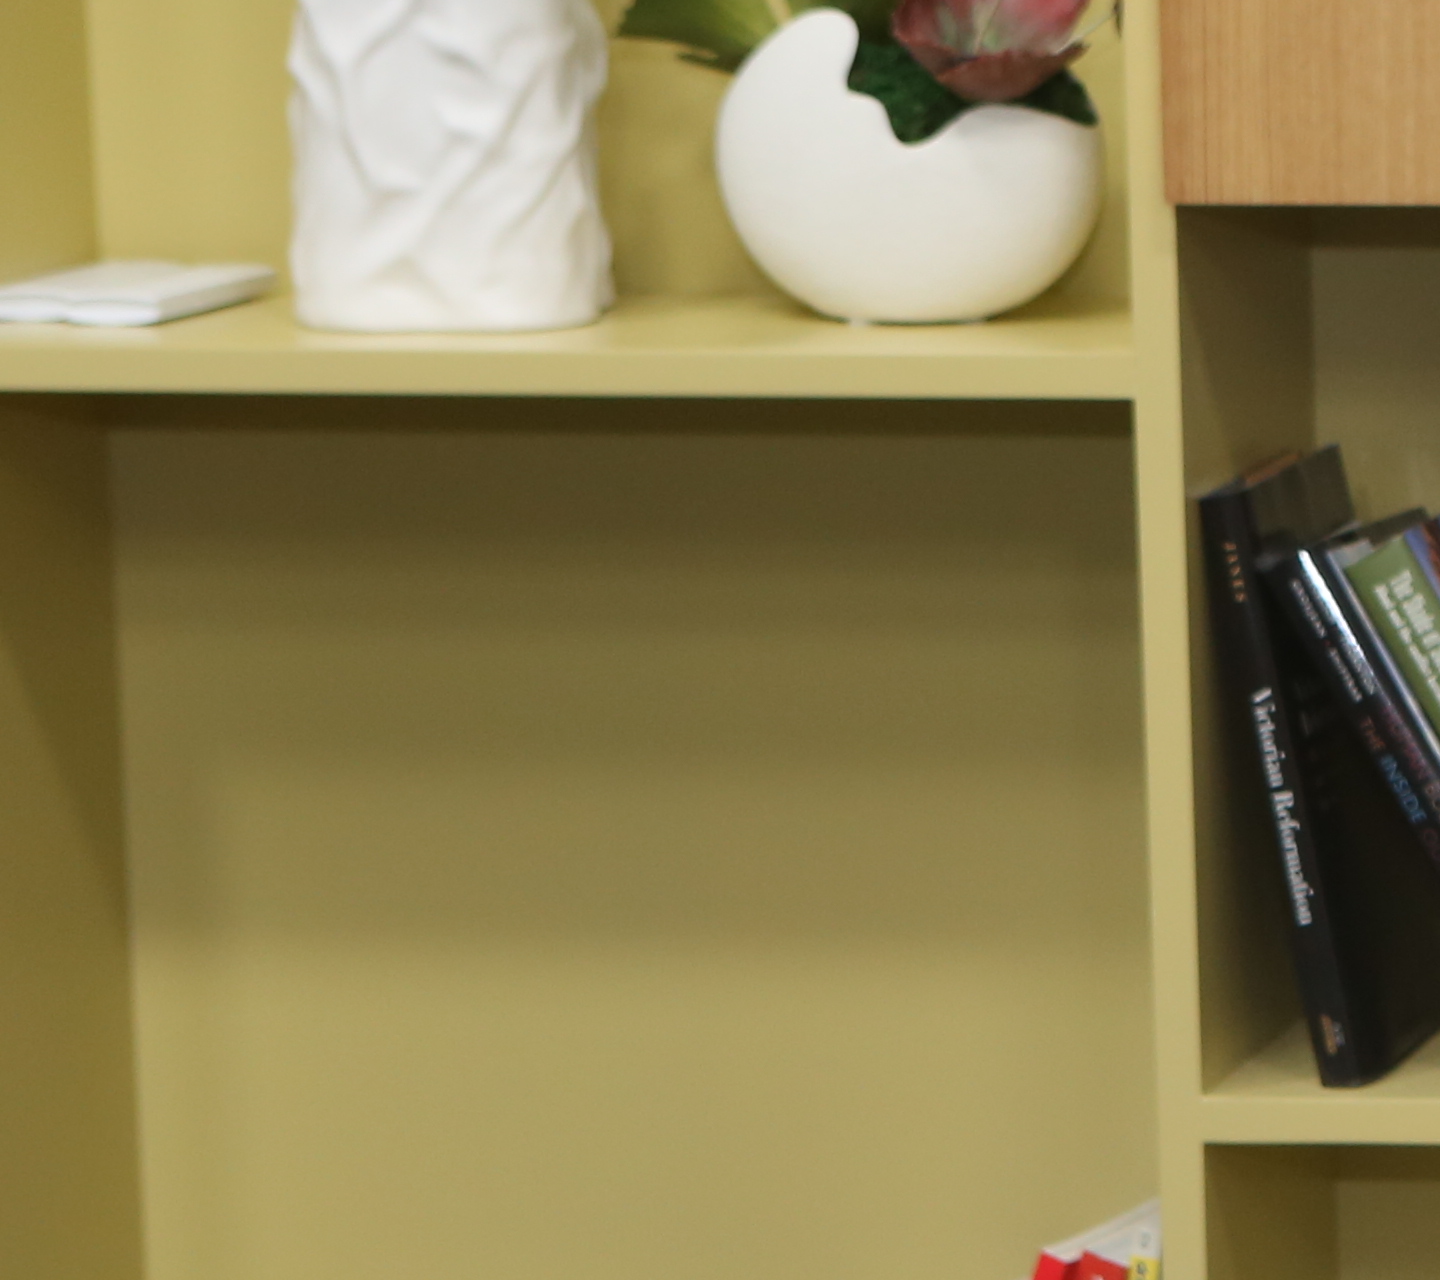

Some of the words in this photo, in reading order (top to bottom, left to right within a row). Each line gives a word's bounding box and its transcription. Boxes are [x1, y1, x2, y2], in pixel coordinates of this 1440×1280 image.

[1241, 684, 1298, 790] Victorian
[1357, 716, 1388, 754] THE
[1376, 751, 1430, 825] INSIDE
[1261, 786, 1329, 927] Reformation
